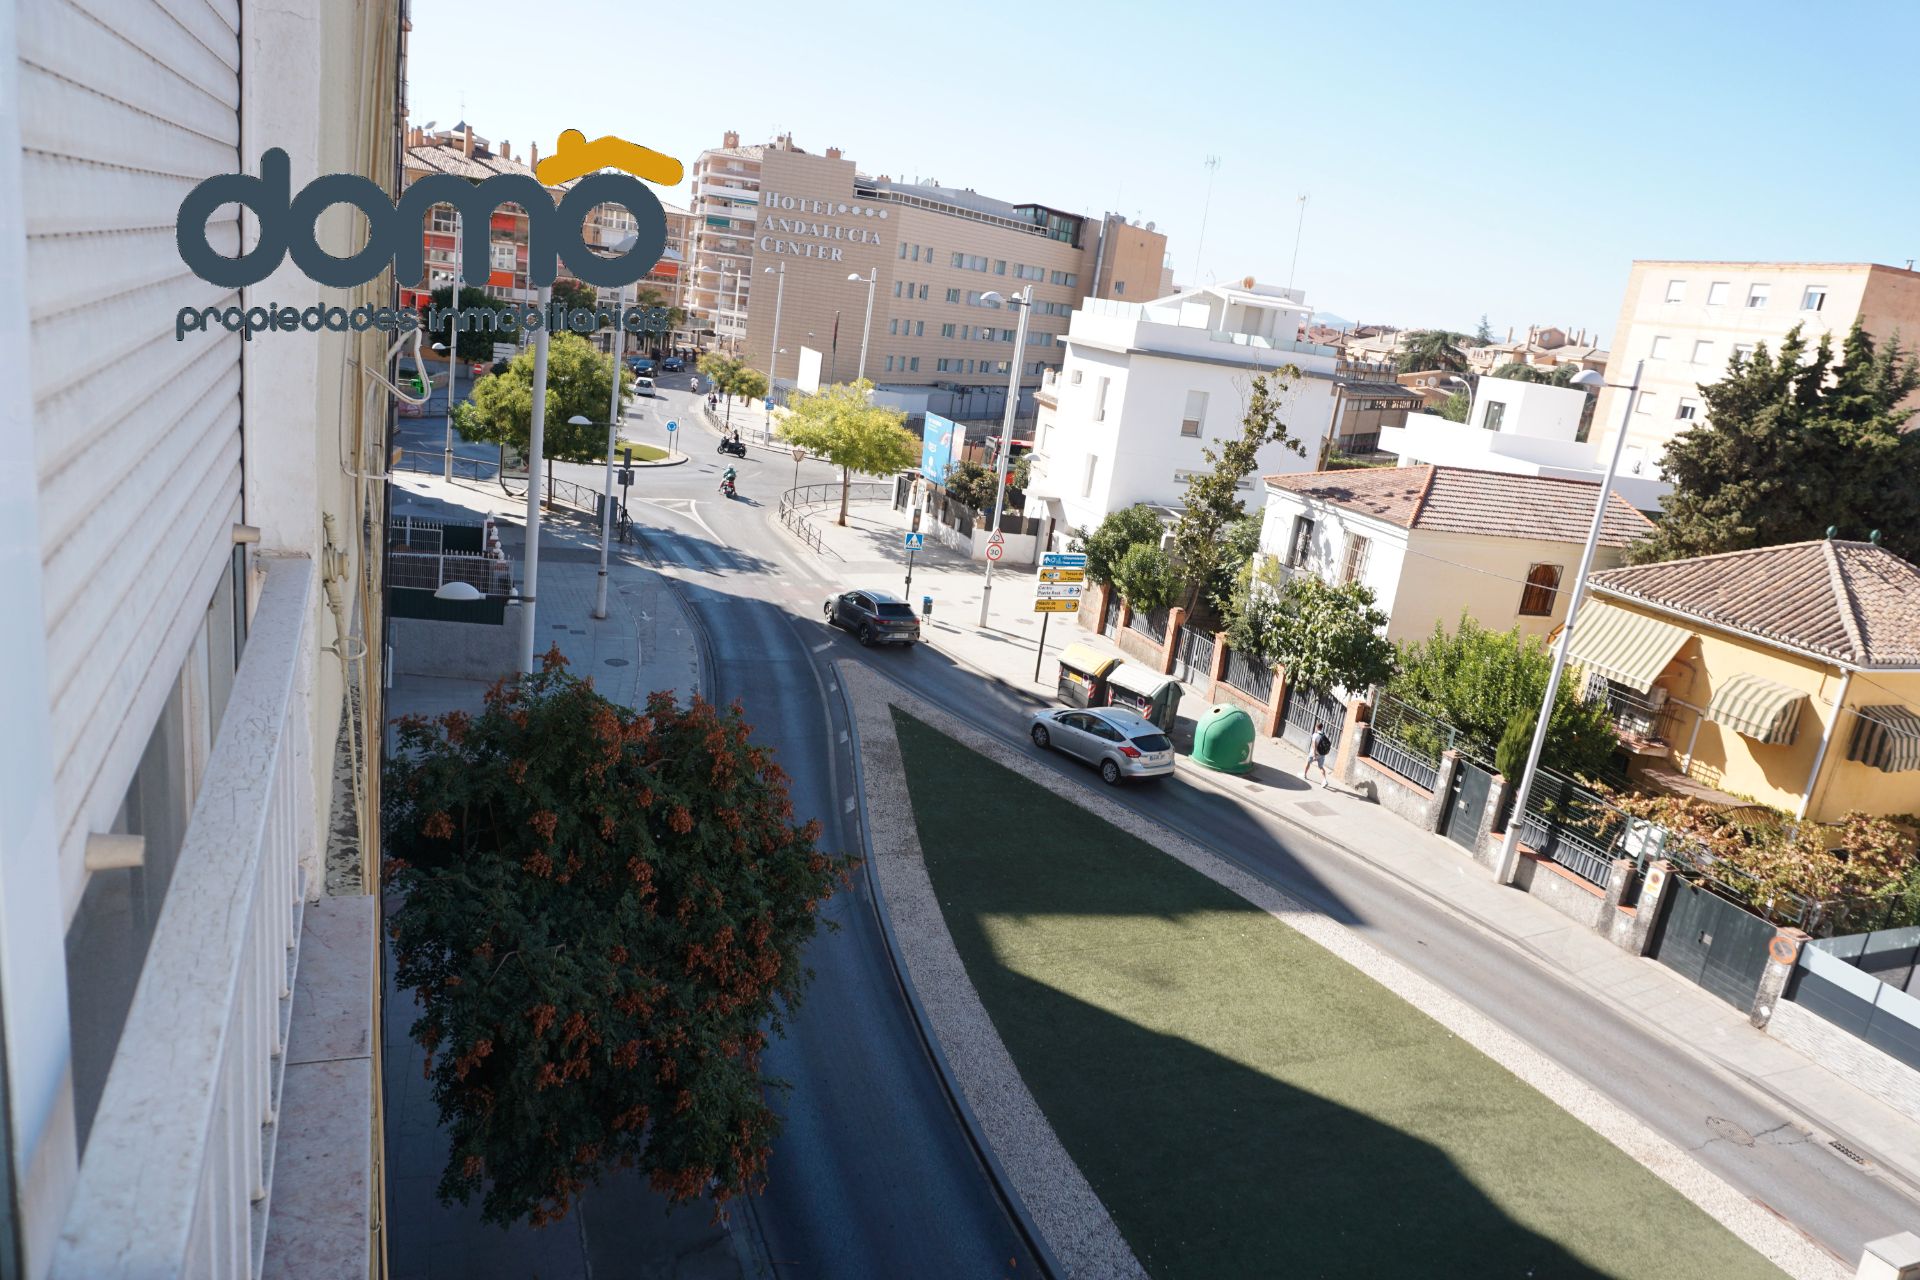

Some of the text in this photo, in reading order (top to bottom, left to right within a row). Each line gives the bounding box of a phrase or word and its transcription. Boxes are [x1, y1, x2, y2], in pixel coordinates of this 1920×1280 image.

[765, 191, 837, 217] HOTEL
[762, 214, 881, 245] ANDALUCIA
[760, 236, 844, 262] CENTER
